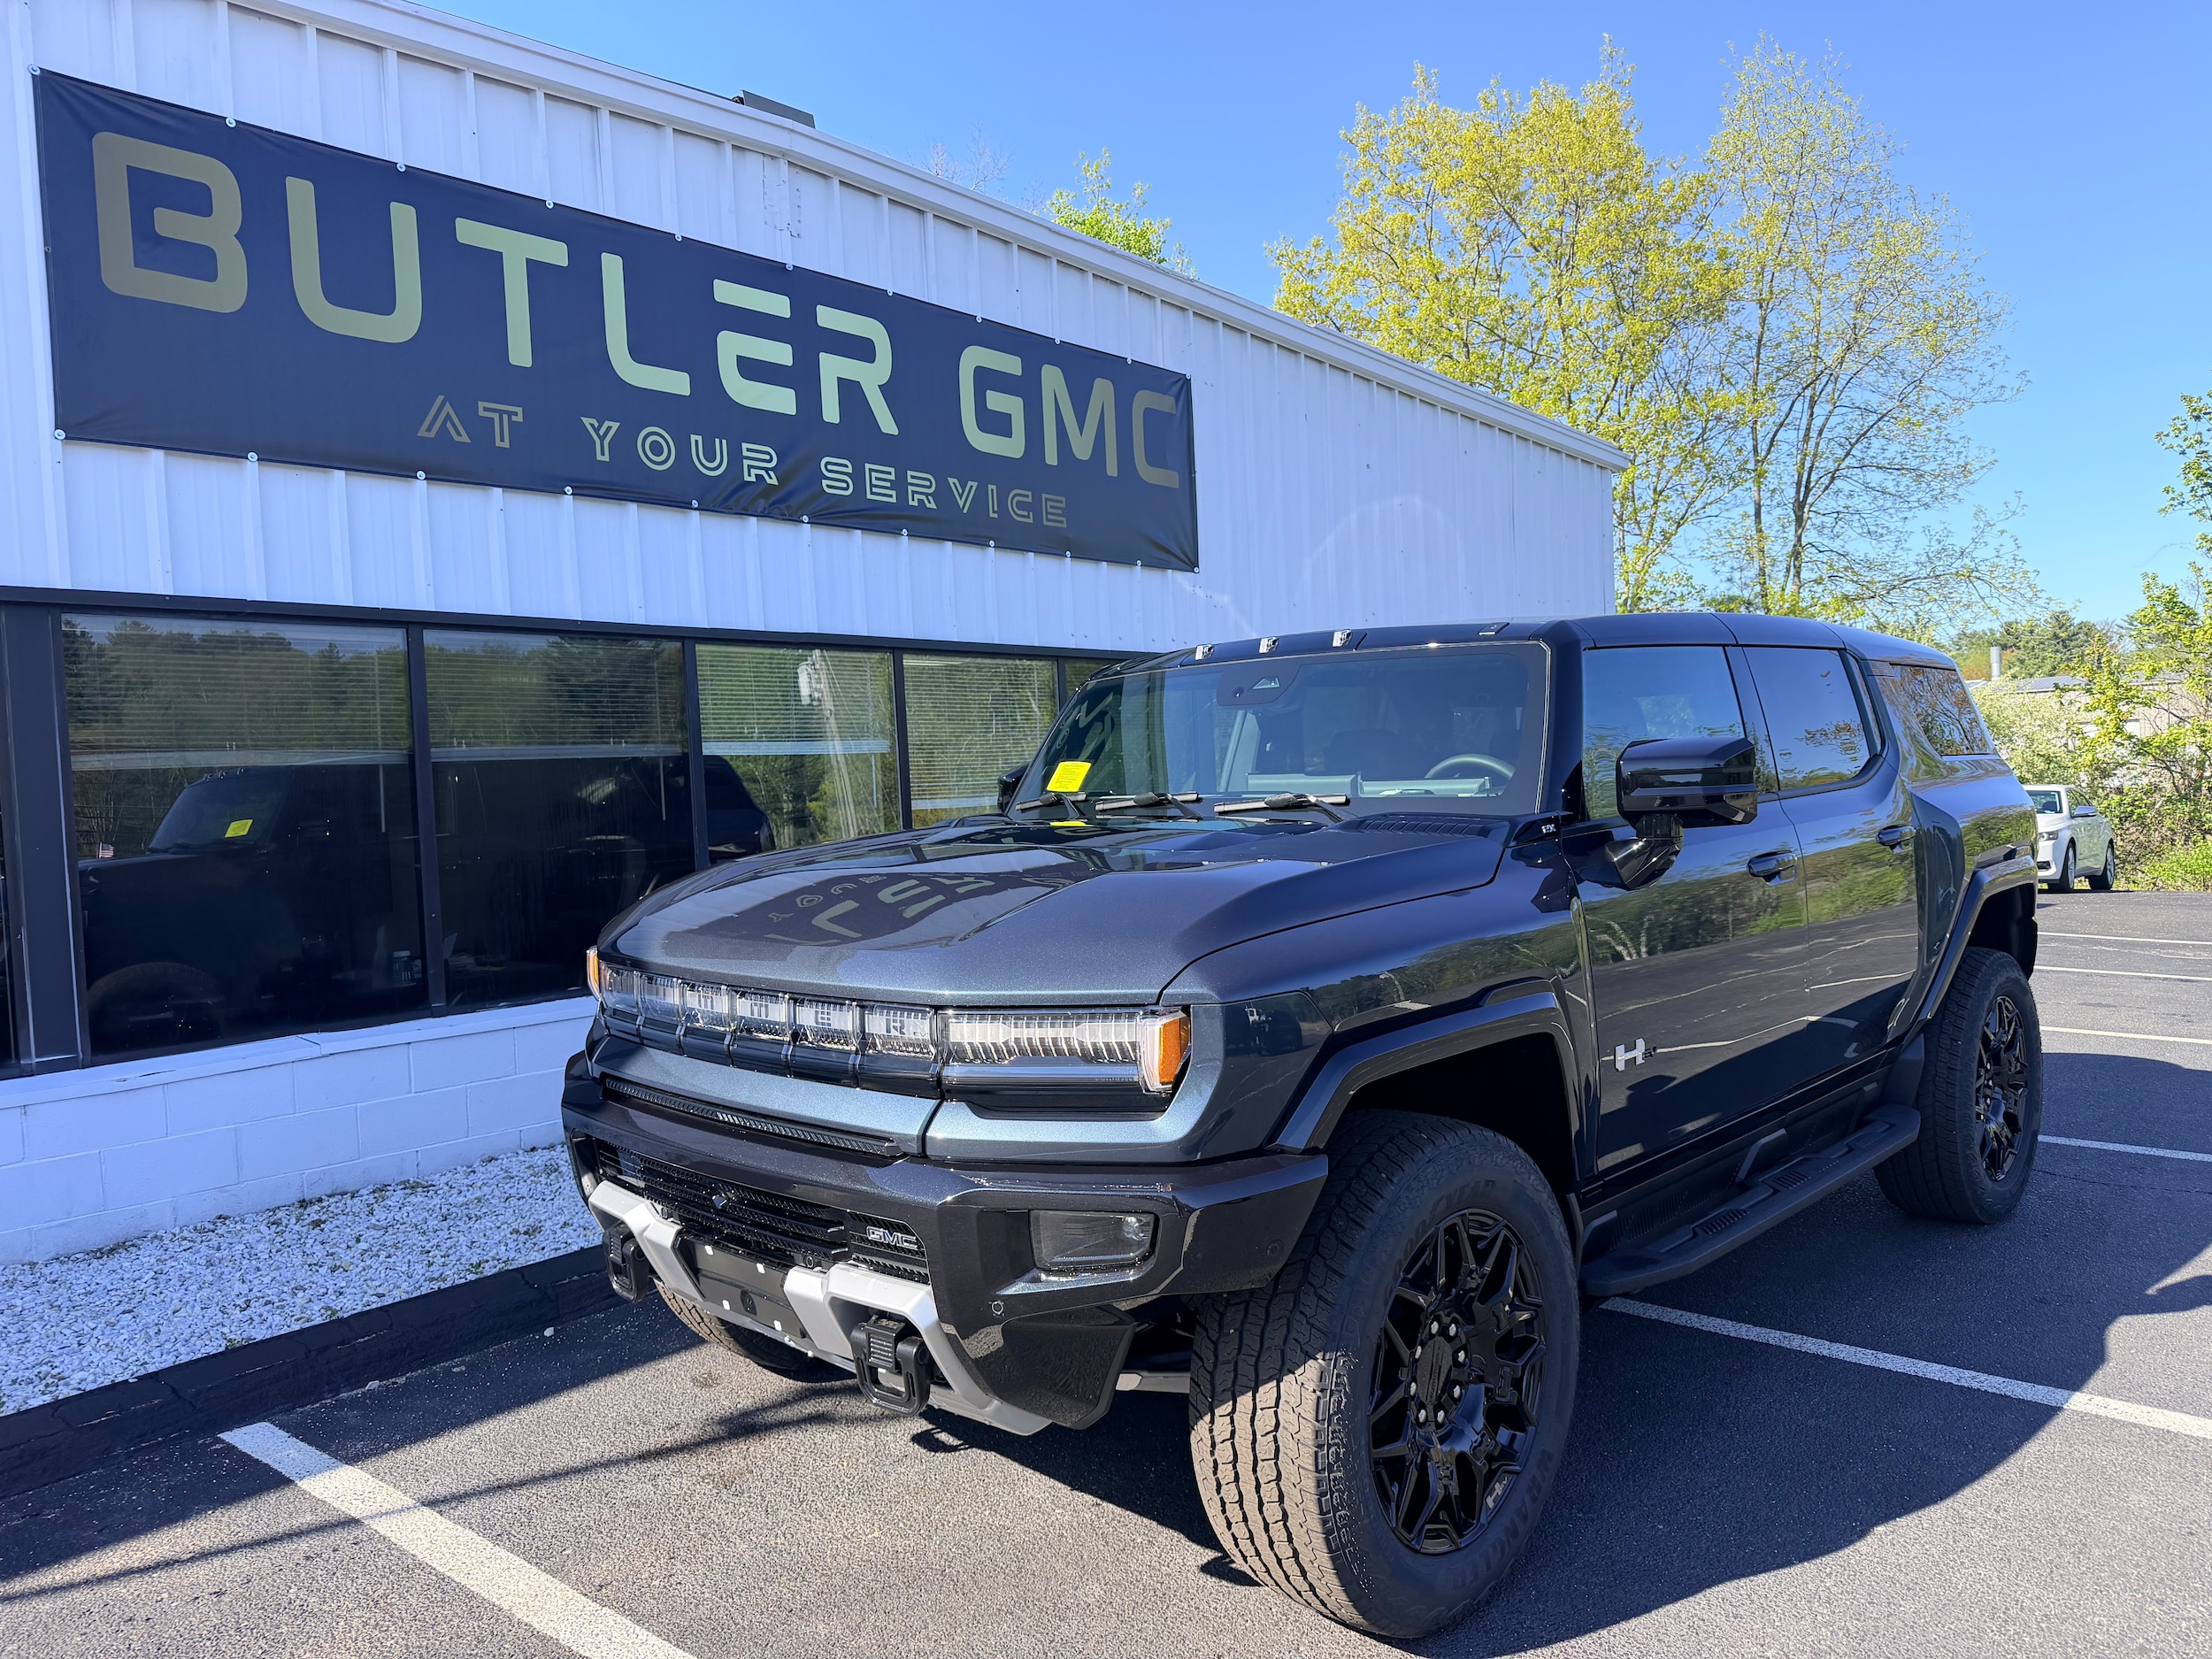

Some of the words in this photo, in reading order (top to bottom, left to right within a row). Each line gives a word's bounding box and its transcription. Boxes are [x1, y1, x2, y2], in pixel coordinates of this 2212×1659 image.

[91, 130, 899, 435] BUTLER
[958, 344, 1180, 489] GMC
[417, 394, 524, 449] AT
[580, 416, 780, 486] YOUR
[819, 455, 1067, 529] SERVICE
[865, 1225, 919, 1251] GMC
